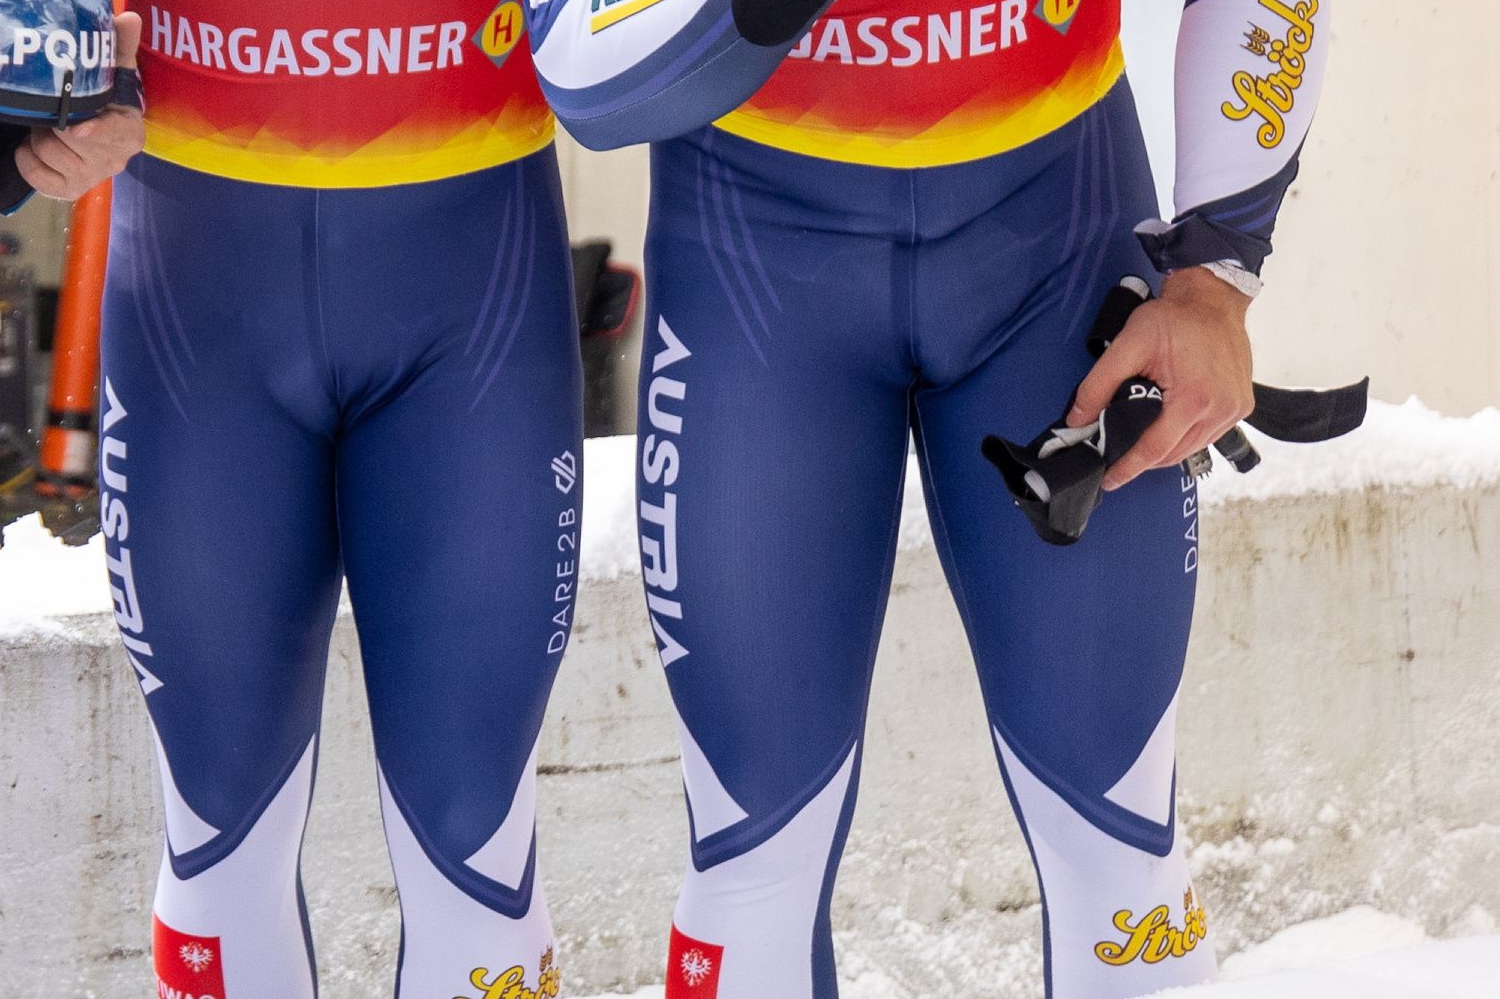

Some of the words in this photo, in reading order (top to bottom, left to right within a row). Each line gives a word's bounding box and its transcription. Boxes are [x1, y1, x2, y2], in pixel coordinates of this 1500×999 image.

[151, 4, 467, 77] HARGASSNER
[102, 376, 164, 695] AUSTRIA
[639, 314, 693, 667] AUSTRIA
